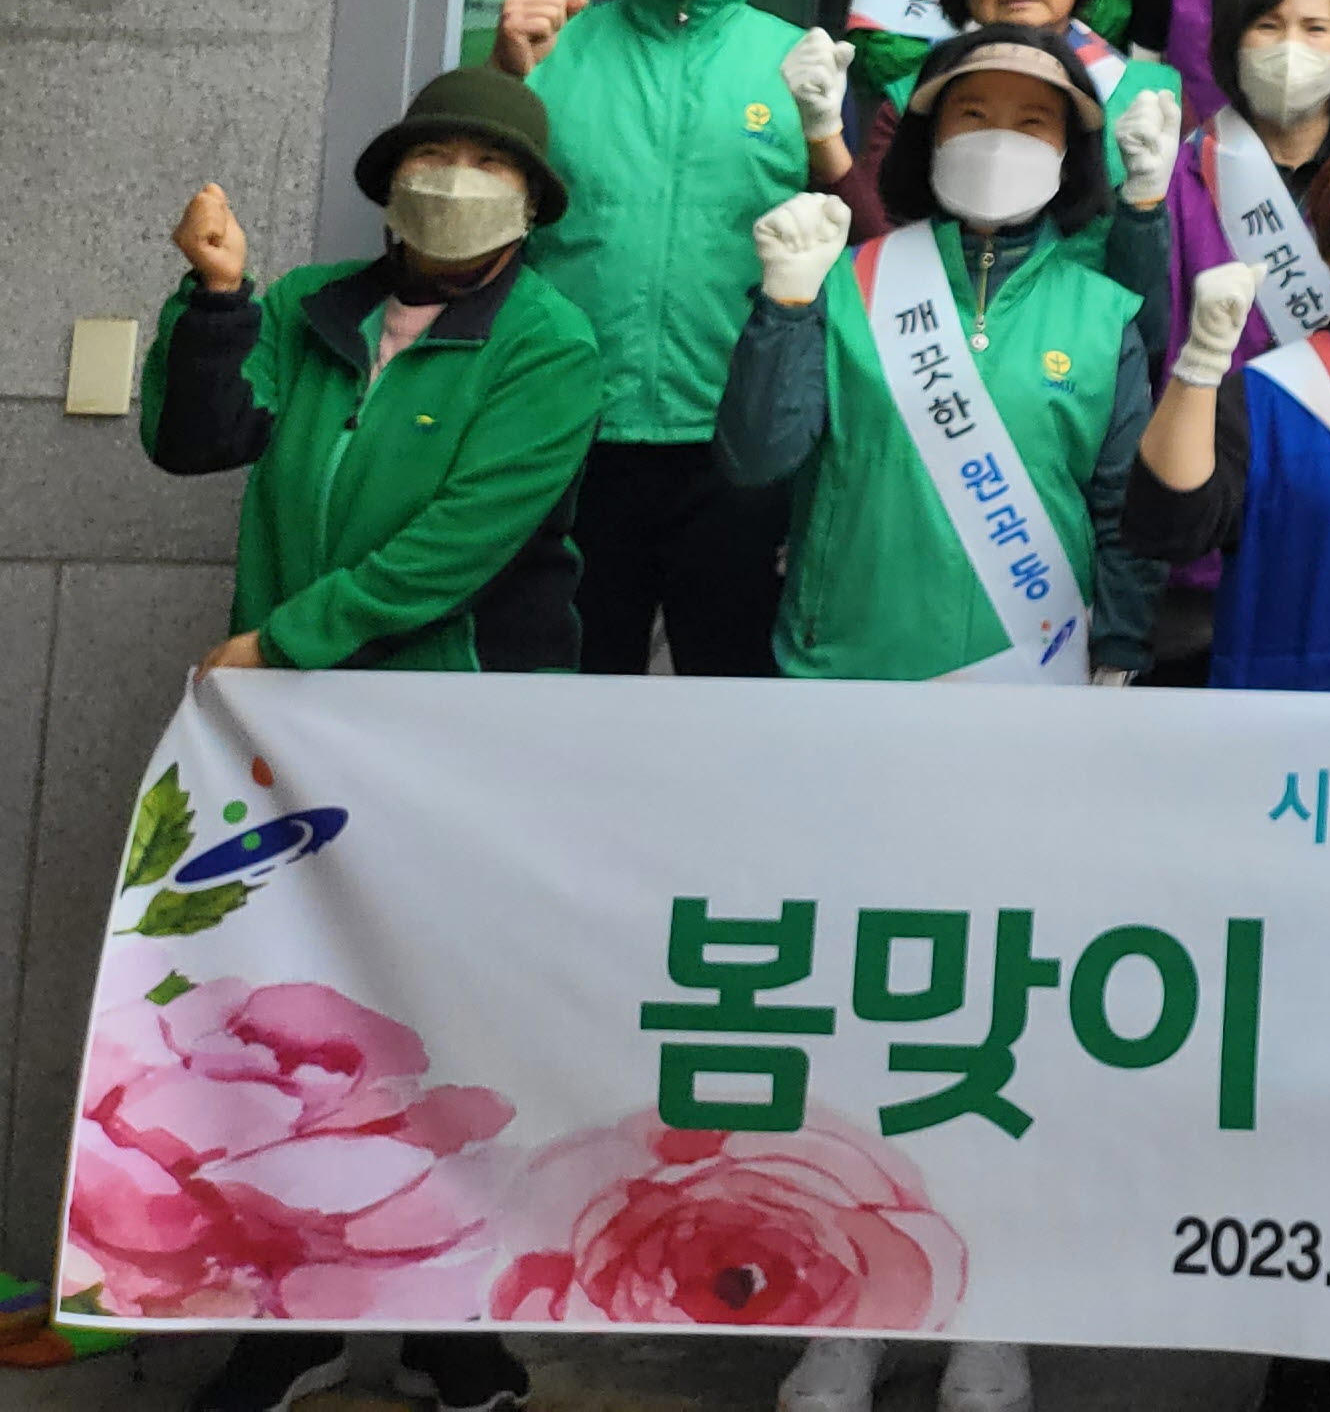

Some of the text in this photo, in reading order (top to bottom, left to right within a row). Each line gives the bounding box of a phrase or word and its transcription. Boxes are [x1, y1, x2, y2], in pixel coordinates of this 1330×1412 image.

[1240, 199, 1330, 329] 깨끗한
[896, 300, 1052, 601] 깨끗한 원곡동
[639, 896, 1265, 1140] 봄맞이
